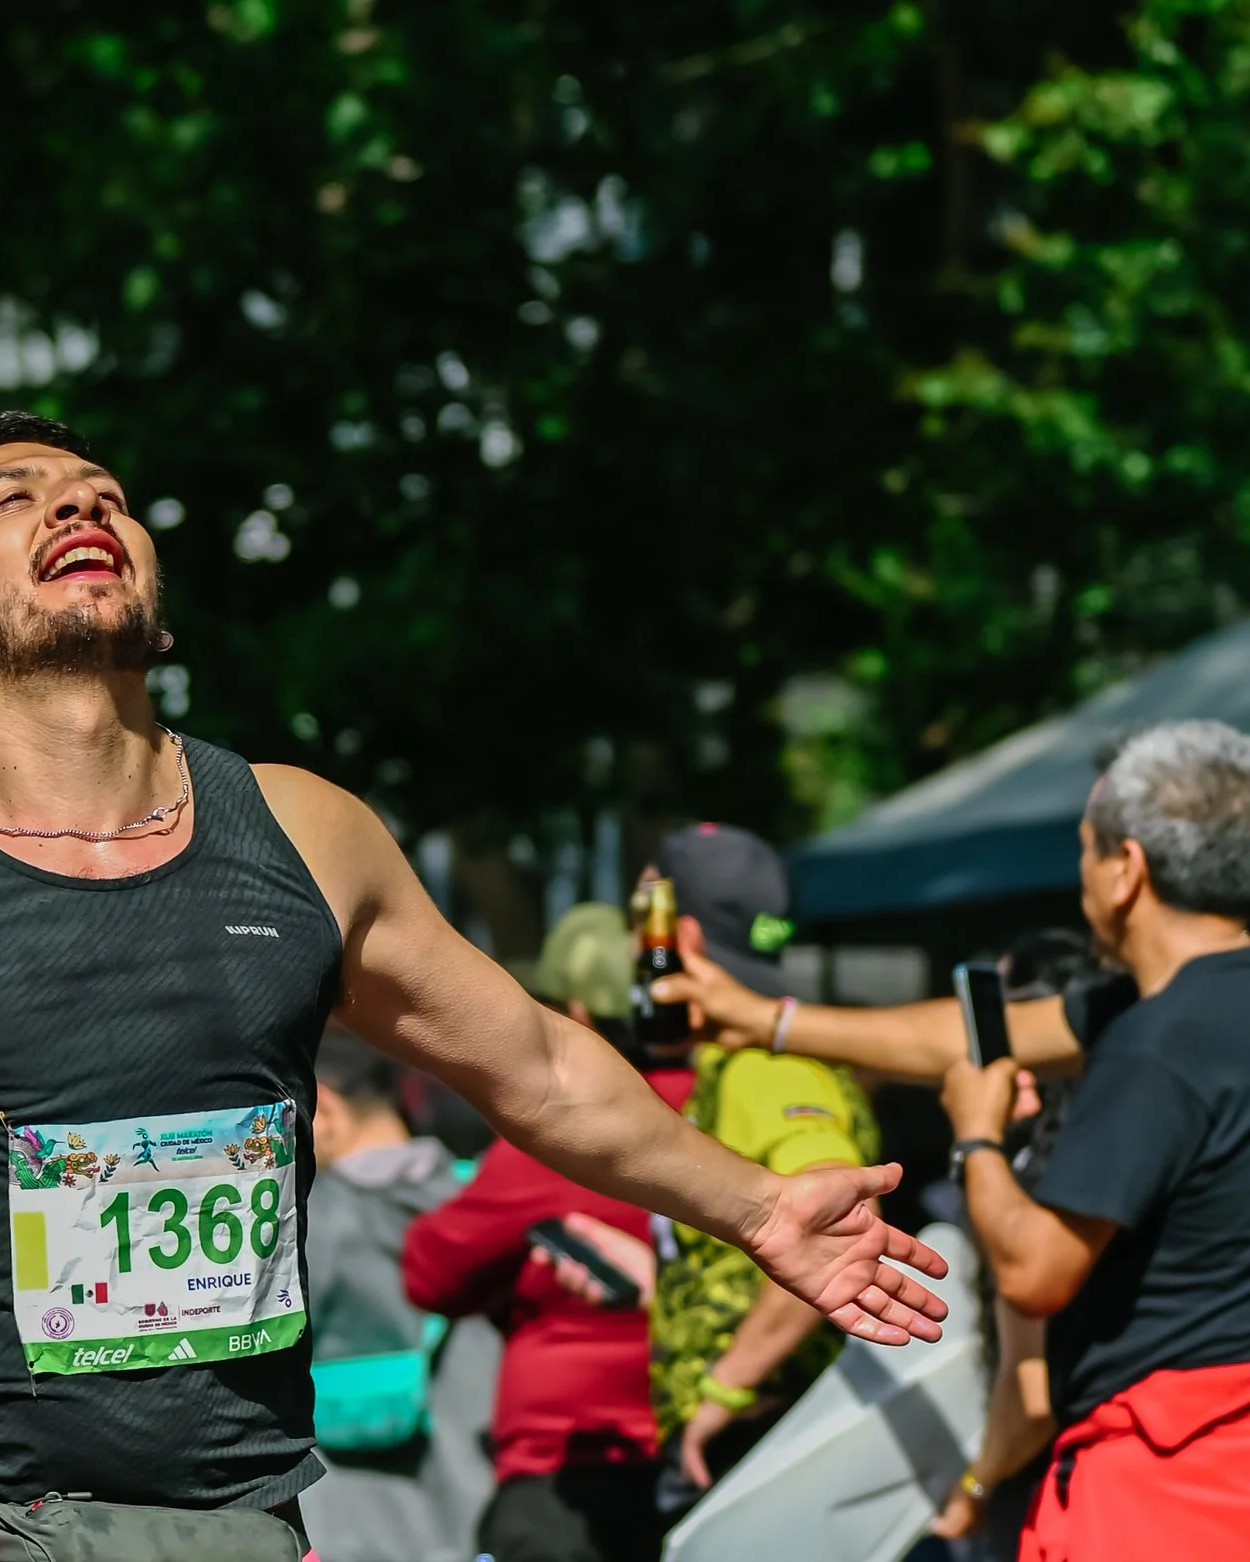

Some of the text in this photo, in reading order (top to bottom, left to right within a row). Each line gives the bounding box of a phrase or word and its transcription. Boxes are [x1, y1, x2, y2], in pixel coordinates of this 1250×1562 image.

[160, 1139, 182, 1147] CIUDAD
[190, 1137, 213, 1145] MÉXICO
[176, 1146, 198, 1155] telcel
[99, 1178, 280, 1274] 1368
[187, 1272, 252, 1291] ENRIQUE
[181, 1305, 221, 1317] INDEPORTE
[228, 1329, 272, 1352] BBVA
[72, 1343, 135, 1368] telcel
